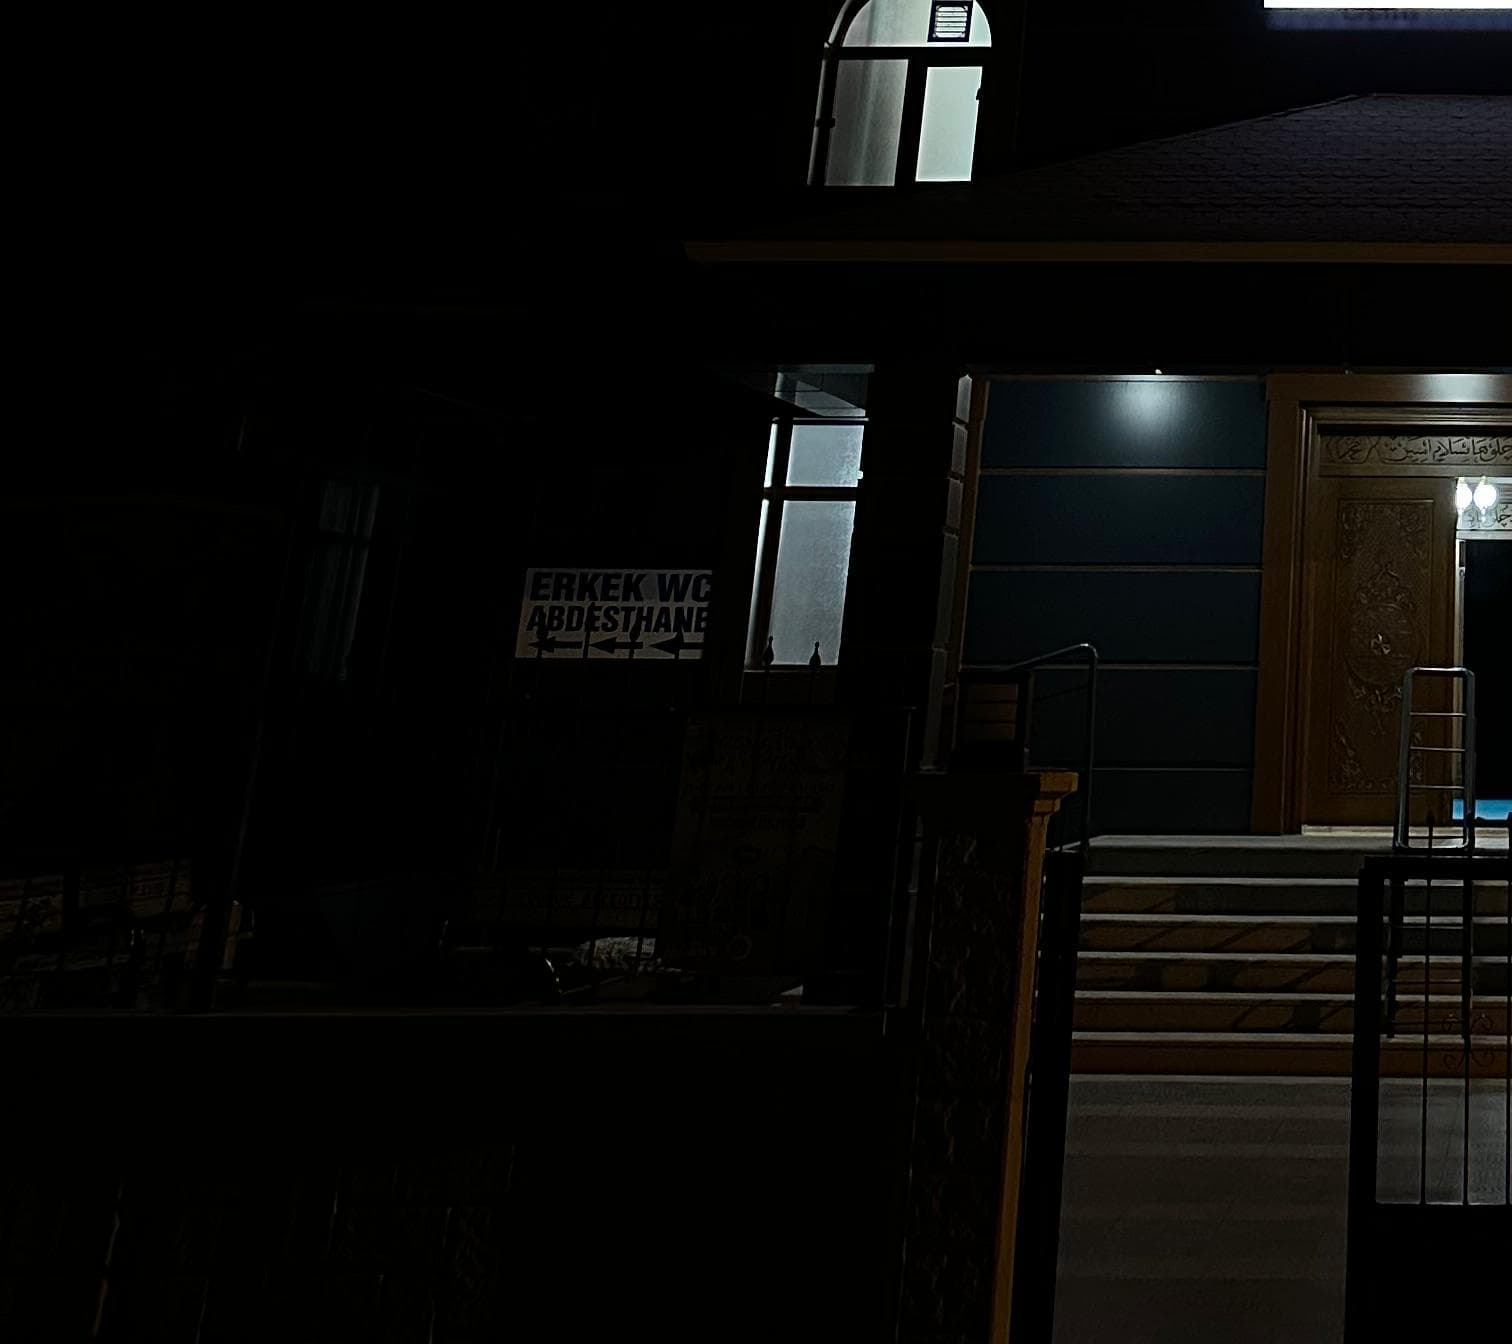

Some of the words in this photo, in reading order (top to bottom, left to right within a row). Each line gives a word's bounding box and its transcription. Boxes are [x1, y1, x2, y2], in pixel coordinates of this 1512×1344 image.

[529, 571, 647, 602] ERKEK
[656, 572, 712, 603] WC
[525, 605, 709, 633] ABDESTHANE
